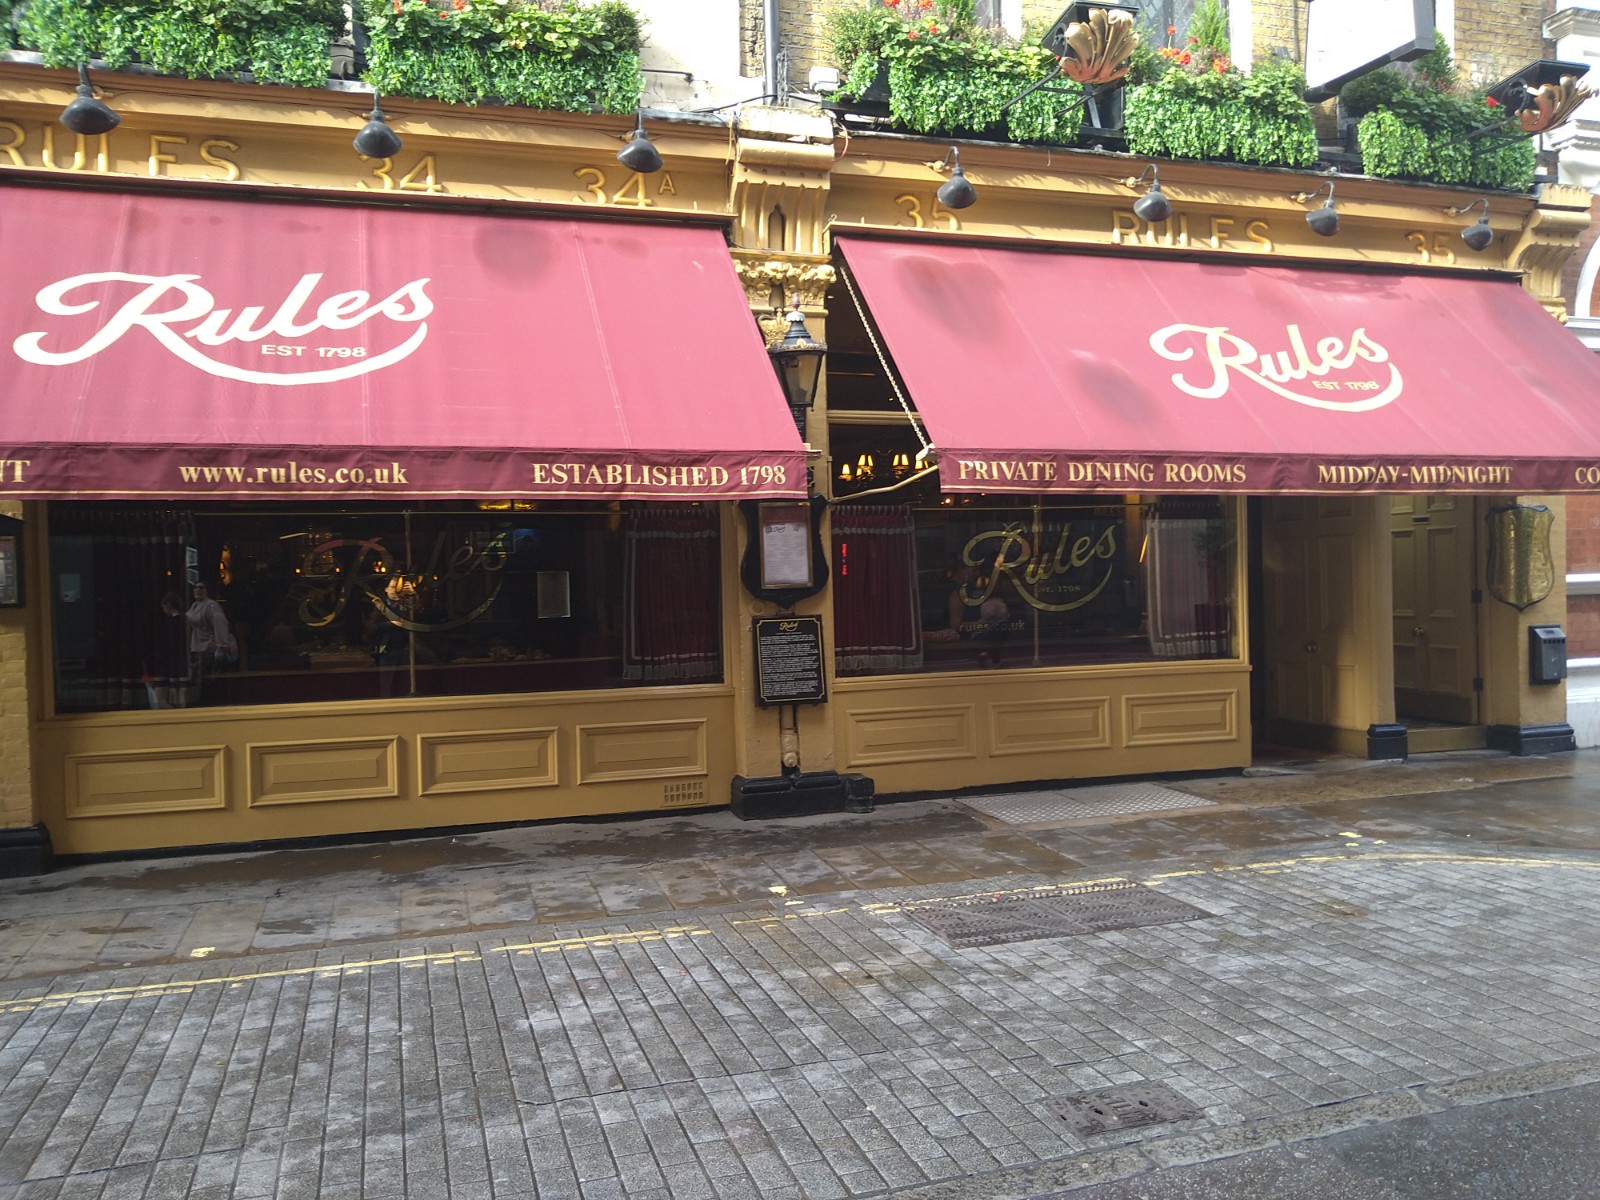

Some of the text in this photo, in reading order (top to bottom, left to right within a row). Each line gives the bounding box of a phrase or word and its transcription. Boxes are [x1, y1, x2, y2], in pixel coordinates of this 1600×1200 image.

[355, 155, 443, 193] 34
[894, 194, 960, 231] 35
[1405, 231, 1456, 264] 35
[13, 271, 434, 386] Rules
[261, 344, 367, 358] EST 1798
[1149, 323, 1403, 412] Rules
[1312, 380, 1379, 391] EST 1798
[178, 461, 409, 484] www.rules.co.uk
[532, 463, 786, 486] ESTABLISHED 1798
[958, 460, 1246, 483] PRIVATE DINING ROOMS
[1318, 465, 1513, 484] MIDDAY-MIDNIGHT
[958, 521, 1117, 612] Rules
[959, 619, 1025, 632] rules.co.uk
